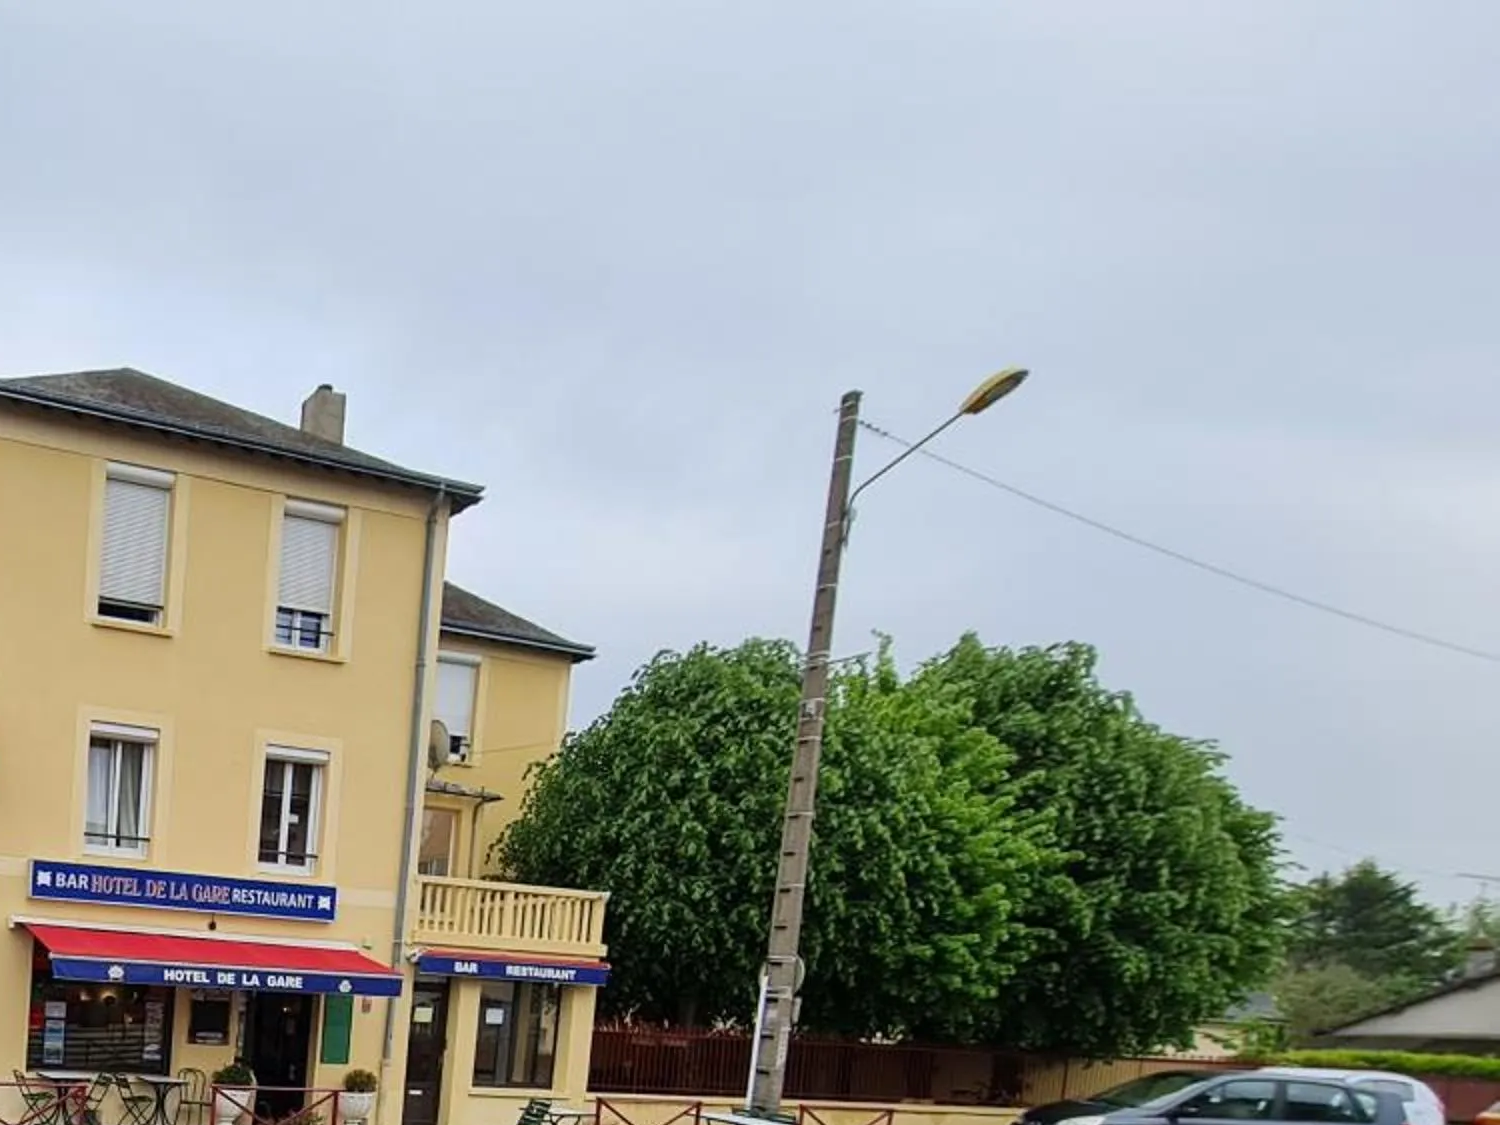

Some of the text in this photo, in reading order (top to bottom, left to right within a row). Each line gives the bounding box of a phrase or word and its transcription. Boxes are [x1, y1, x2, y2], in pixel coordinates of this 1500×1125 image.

[54, 871, 315, 910] BAR HOTEL DE LA GARE RESTAURANT
[163, 969, 304, 989] HOTEL DE LA GARE
[454, 961, 577, 981] BAR RESTAURANT
